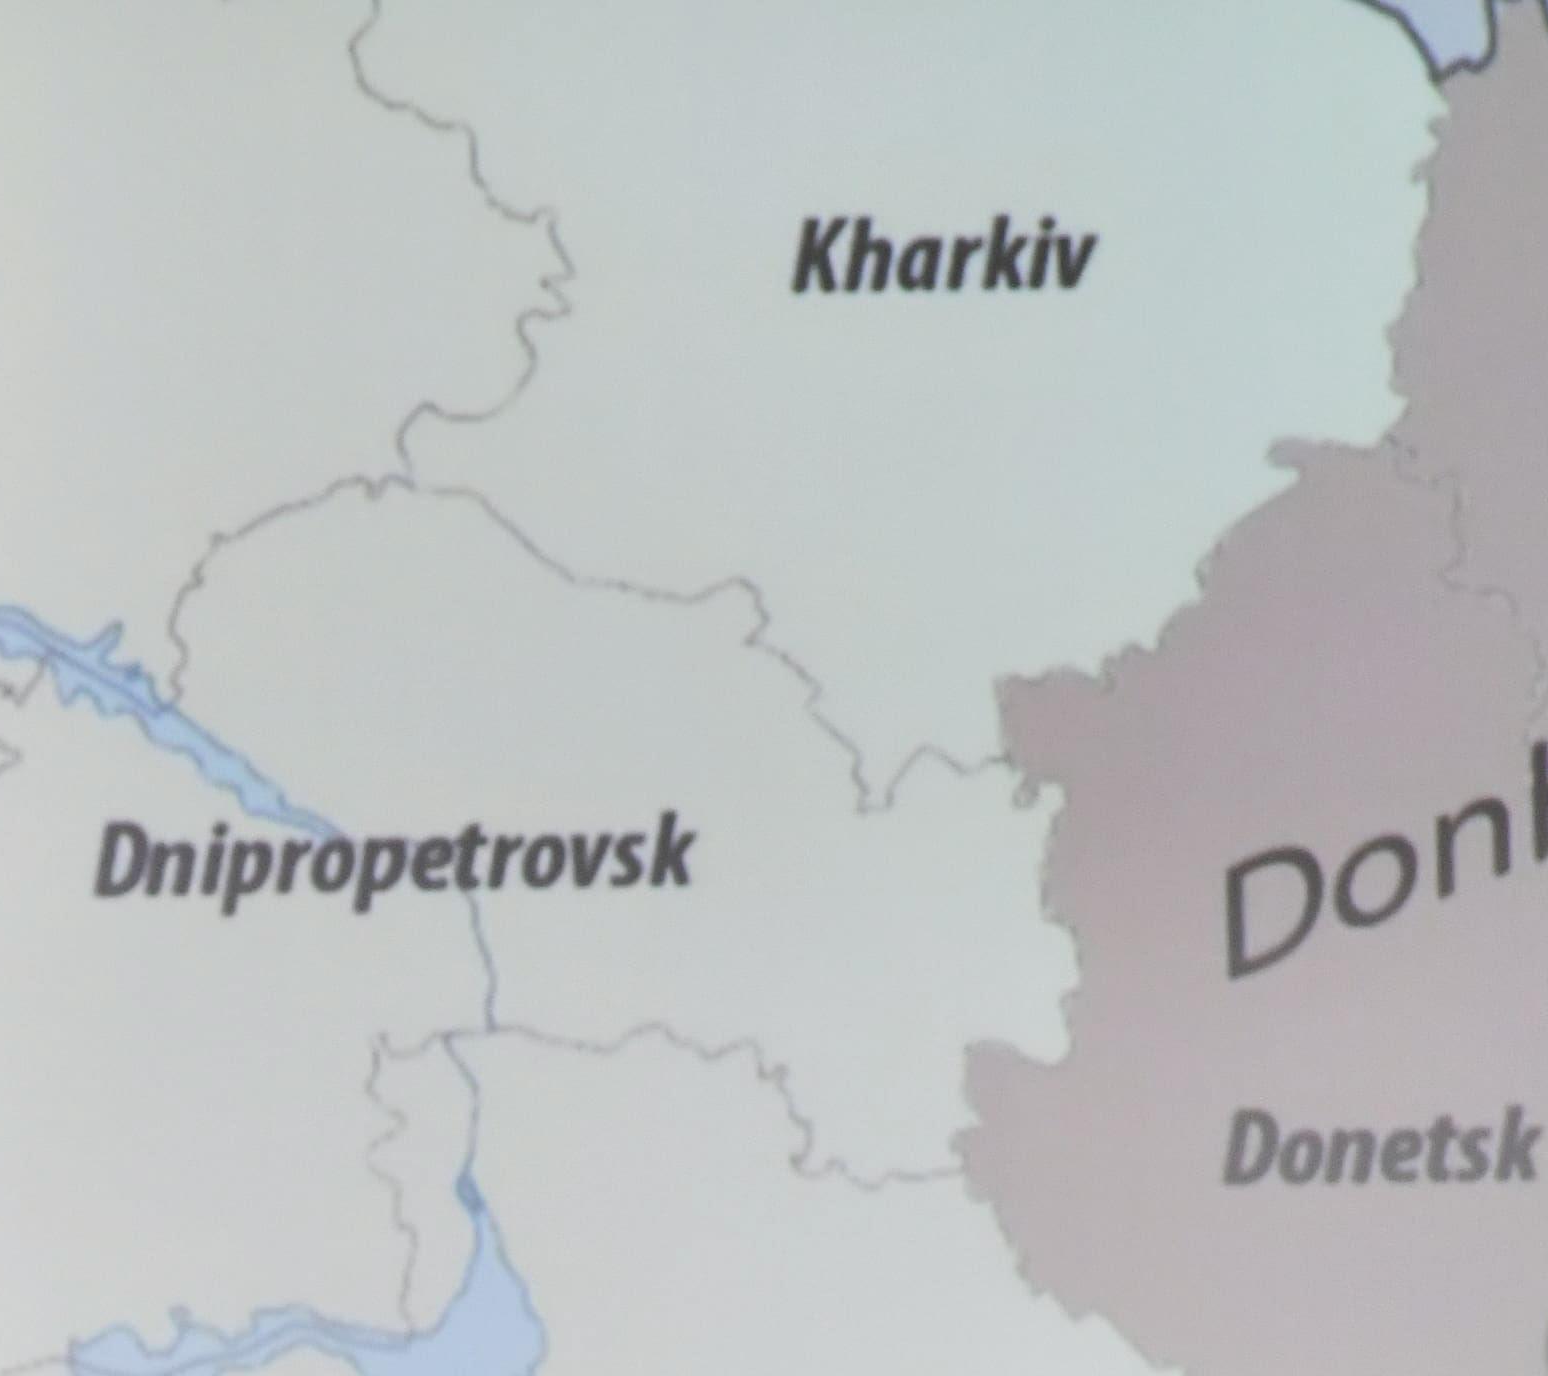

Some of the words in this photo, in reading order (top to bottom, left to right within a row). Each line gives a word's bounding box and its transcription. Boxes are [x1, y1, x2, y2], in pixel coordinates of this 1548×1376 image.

[792, 214, 1098, 295] Kharkiv
[93, 809, 697, 917] Dnipropetrovsk
[1221, 1103, 1543, 1187] Donetsk
